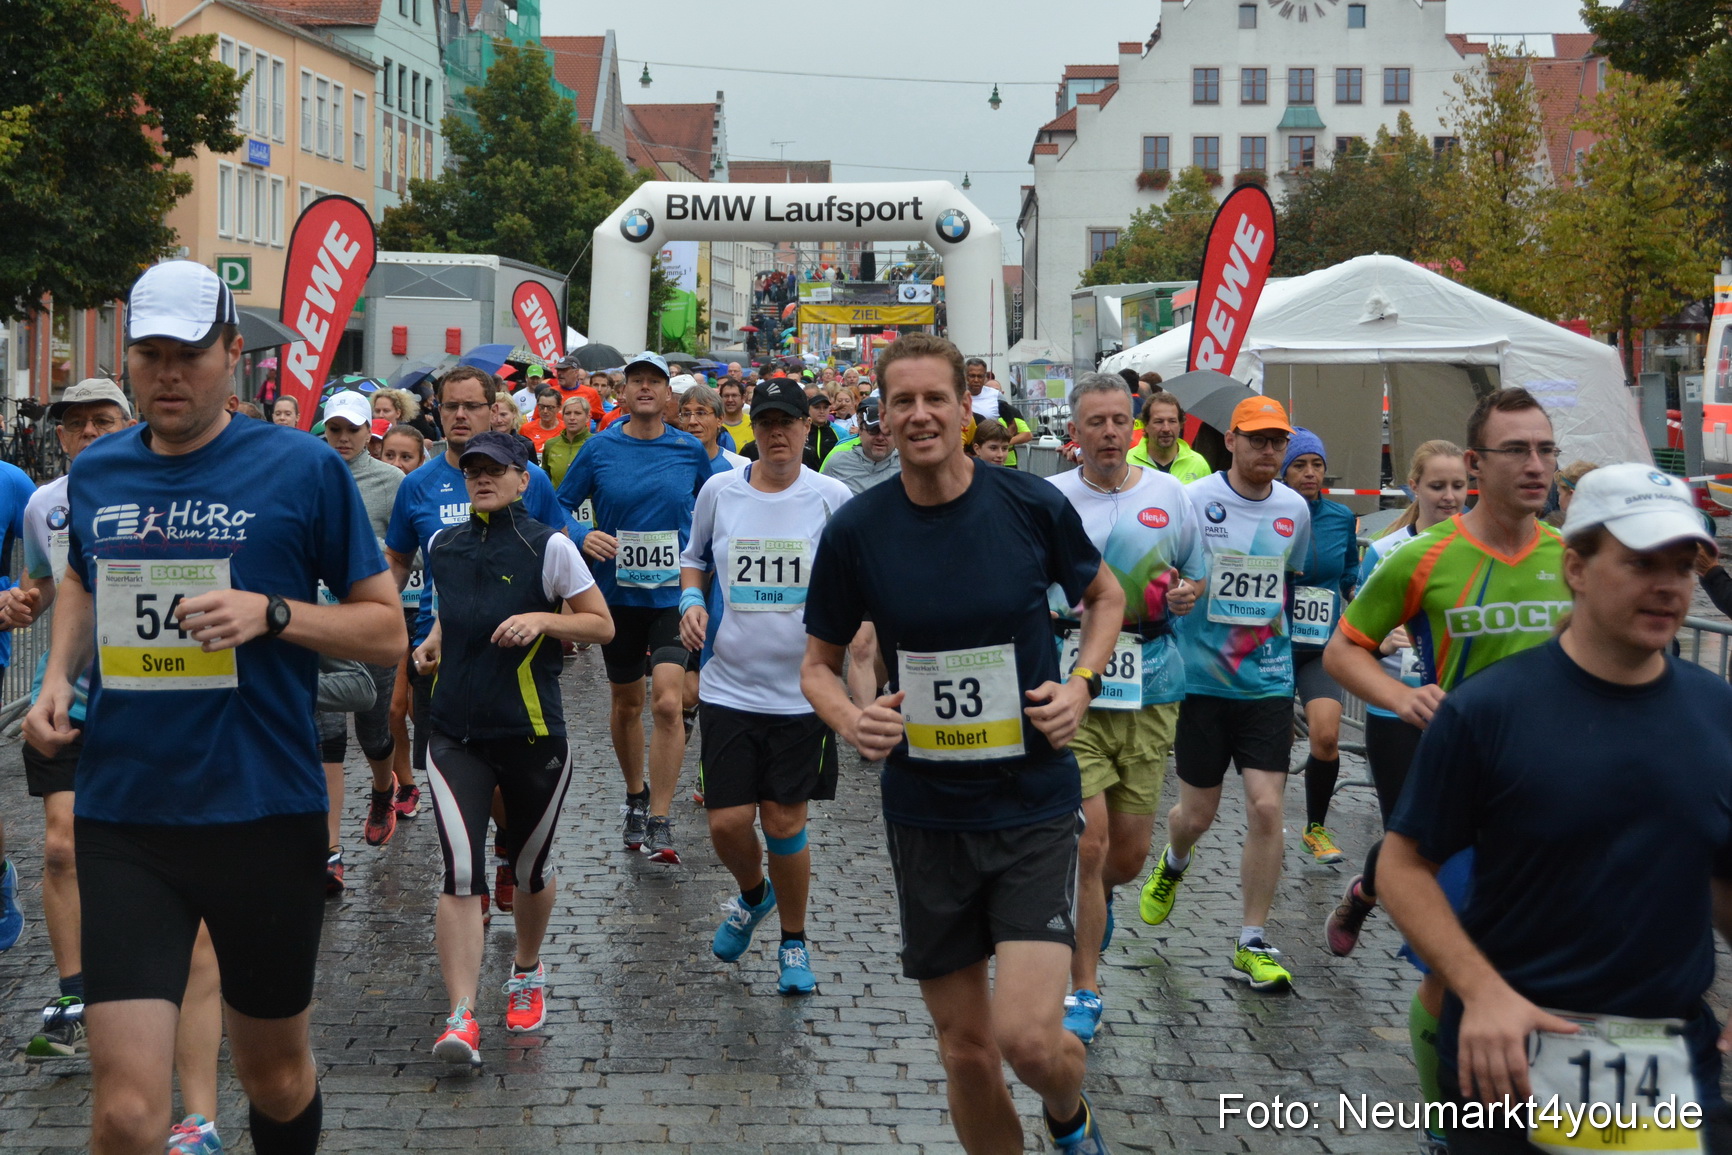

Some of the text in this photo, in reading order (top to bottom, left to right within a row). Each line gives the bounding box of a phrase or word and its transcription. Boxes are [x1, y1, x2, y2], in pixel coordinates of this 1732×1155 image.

[666, 193, 923, 228] BMW Laufsport
[222, 262, 245, 285] D
[1195, 213, 1264, 372] REWE
[286, 220, 361, 391] REWE
[852, 309, 882, 320] ZIEL
[520, 293, 560, 366] REWE
[1625, 493, 1653, 504] BMW
[167, 499, 256, 527] HiRo
[1142, 512, 1167, 523] Hervis
[166, 526, 247, 541] Run 21.1
[643, 533, 672, 542] BOCK
[1205, 526, 1228, 534] PARTL
[765, 540, 803, 550] BOCK
[623, 545, 675, 568] 3045
[1247, 558, 1279, 568] BOCK
[150, 565, 217, 580] BOCK
[629, 571, 661, 581] Robert
[737, 555, 800, 583] 2111
[106, 575, 143, 583] NeuerMarkt
[1219, 571, 1278, 599] 2612
[754, 589, 783, 604] Tanja
[136, 593, 188, 640] 54
[1228, 603, 1266, 616] Thomas
[1293, 599, 1329, 623] 505
[142, 653, 185, 672] Sven
[905, 664, 939, 672] NeuerMarkt
[945, 650, 1005, 669] BOCK
[933, 677, 983, 720] 53
[935, 728, 988, 746] Robert
[1568, 1049, 1660, 1107] 114
